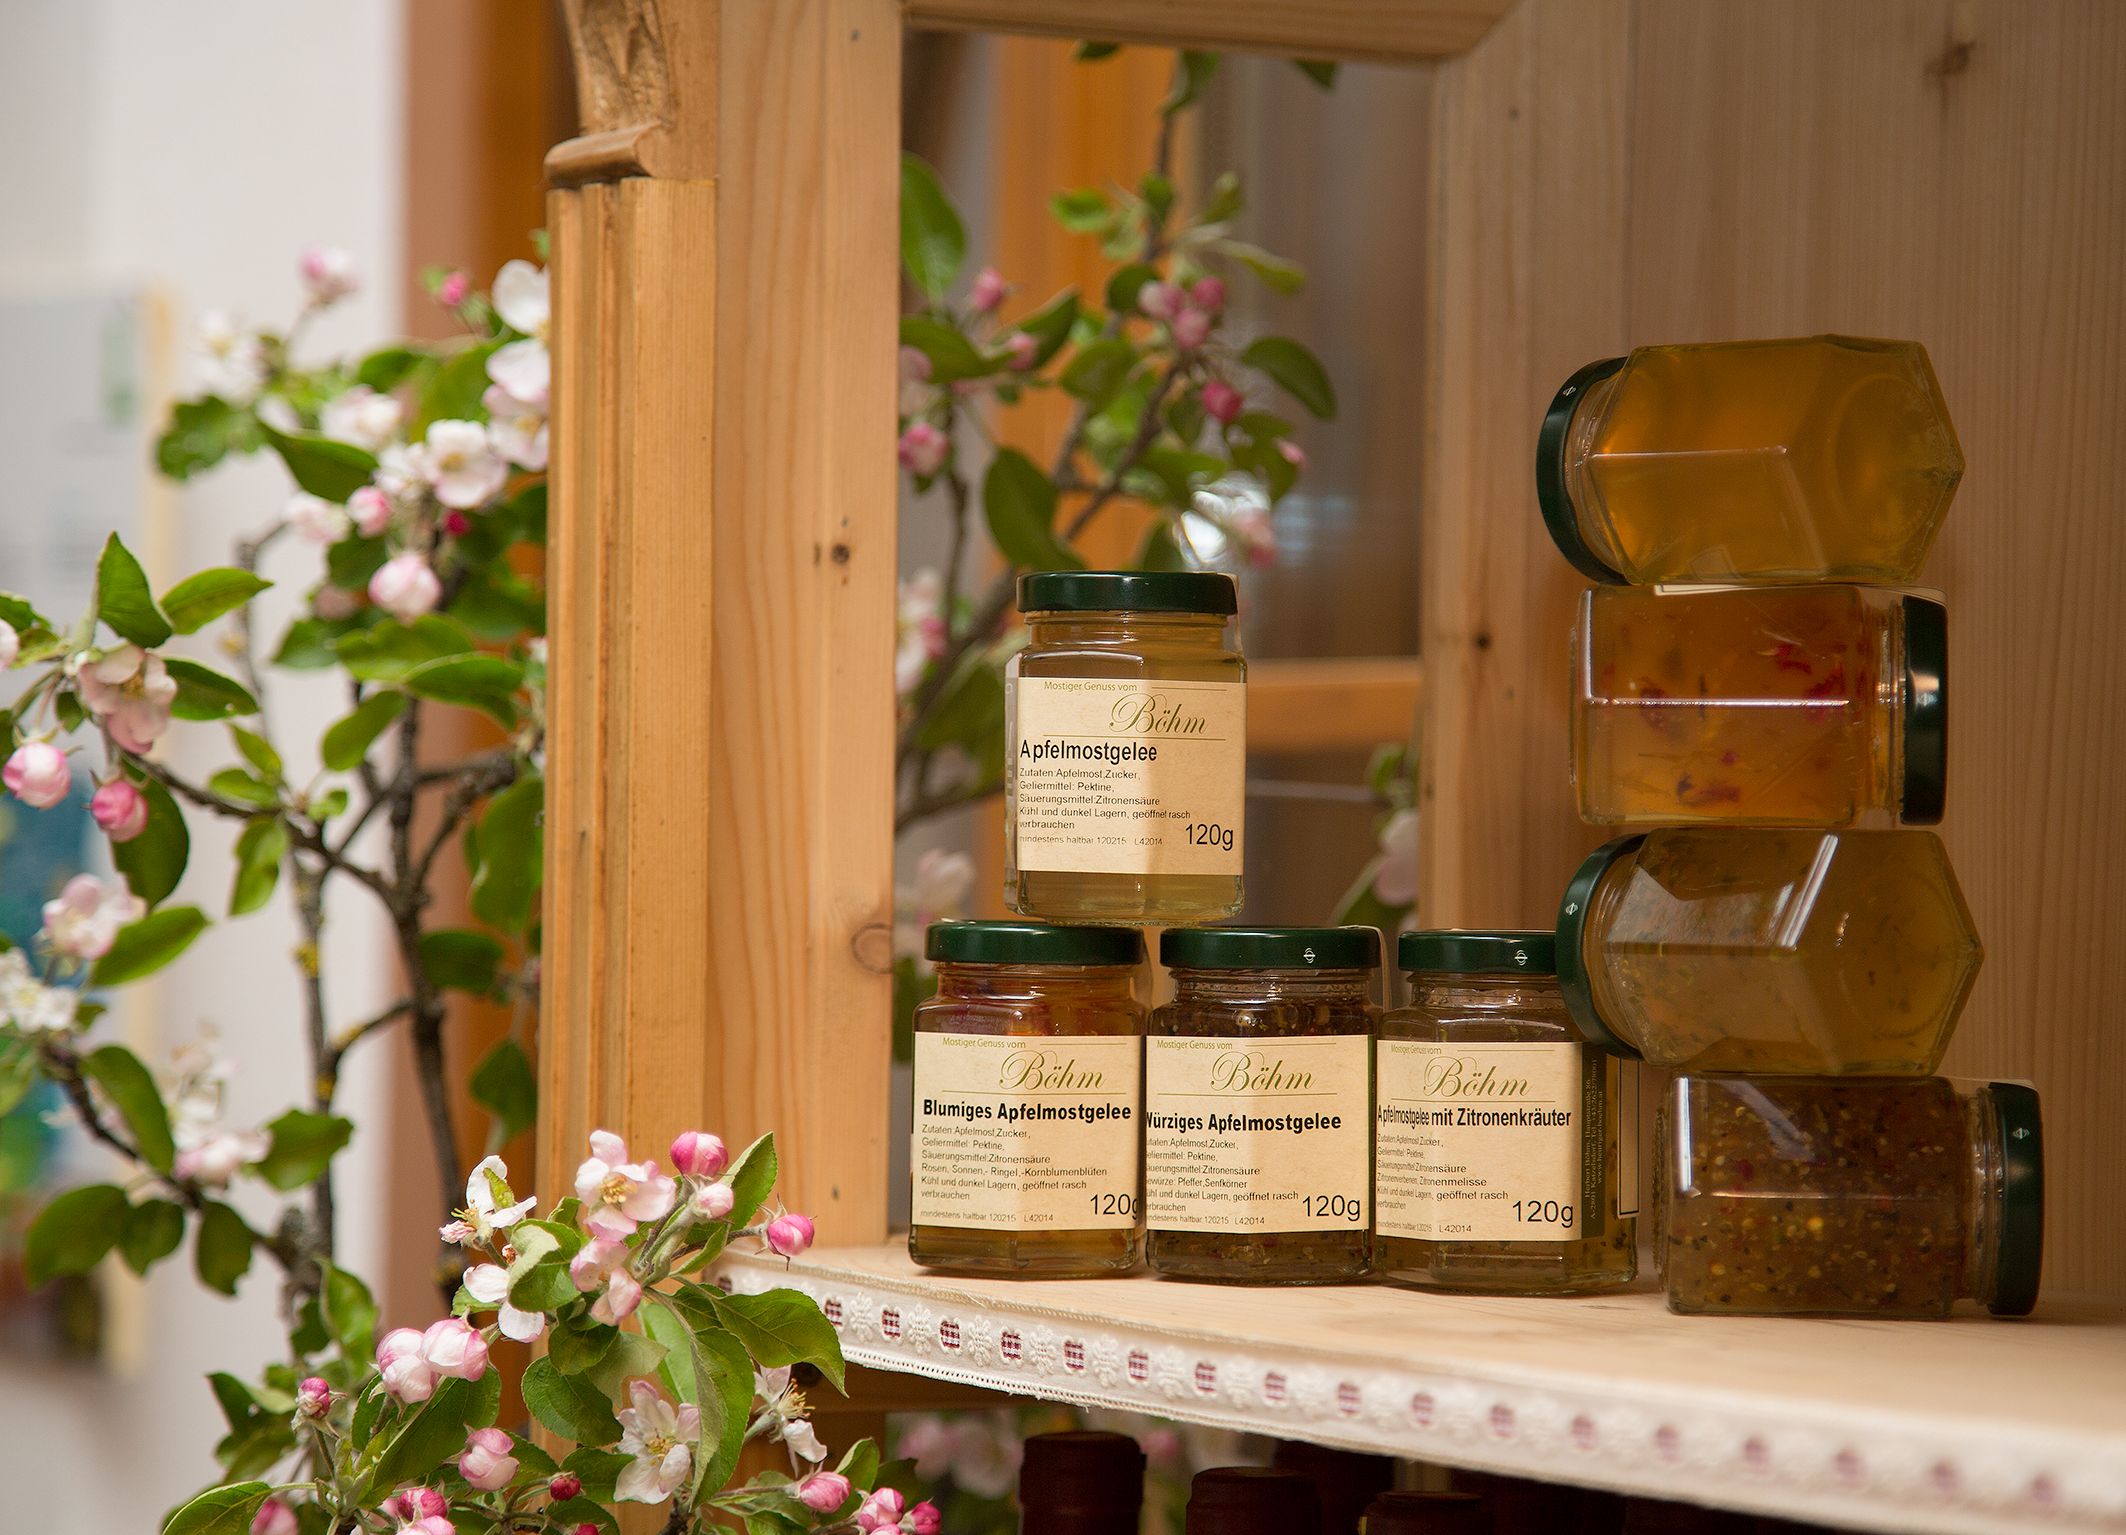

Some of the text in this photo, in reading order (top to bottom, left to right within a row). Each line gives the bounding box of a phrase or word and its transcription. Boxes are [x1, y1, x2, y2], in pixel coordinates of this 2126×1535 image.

[1044, 681, 1137, 692] Mostiger Genuss vom
[1108, 692, 1208, 735] Böhm
[1020, 739, 1158, 766] Apfelmostgelee
[1077, 781, 1115, 793] Pektine,
[1019, 806, 1191, 820] Kühl und dunkel Lagern, geöffnet rasch
[1019, 820, 1234, 852] verbrauchen 120g
[1066, 836, 1094, 844] haltbar
[1097, 836, 1127, 845] 120215
[1134, 837, 1163, 846] L42014
[942, 1037, 1026, 1049] Mostiger Genuss vom
[1156, 1039, 1233, 1050] Mostiger Genuss vom
[1427, 1046, 1442, 1055] vom
[999, 1050, 1106, 1091] Böhm
[1210, 1051, 1317, 1092] Böhm
[1423, 1056, 1533, 1098] Böhm
[923, 1099, 1132, 1124] Blumiges Apfelmostgelee
[1377, 1106, 1572, 1129] Apfelmostgelee mit Zitronenkräuter
[1208, 1112, 1342, 1134] Apfelmostgelee
[1147, 1150, 1185, 1160] eliermittel:
[1147, 1164, 1261, 1176] uerungsmittel:Zitronensäure
[921, 1176, 1087, 1192] Kühl und dunkel Lagern, geöffnet rasch
[1147, 1177, 1175, 1187] ewürze:
[1419, 1176, 1487, 1187] Zitronenmelisse
[920, 1189, 970, 1200] verbrauchen
[1147, 1188, 1299, 1203] ühl und dunkel Lagern, geöffnet rasch
[1390, 1187, 1399, 1195] und
[1399, 1188, 1414, 1197] dunkel
[1436, 1190, 1477, 1202] geöffnet
[1480, 1190, 1509, 1200] rasch
[1147, 1194, 1360, 1222] rbrauchen 120g
[1377, 1200, 1574, 1229] verbrauchen 120g
[962, 1211, 987, 1220] haltbar
[989, 1213, 1017, 1222] 120215
[1023, 1214, 1054, 1223] L42014
[1147, 1214, 1178, 1223] ndestens
[1204, 1216, 1229, 1225] 120215
[1234, 1216, 1265, 1225] L42014
[1439, 1224, 1472, 1233] L42014
